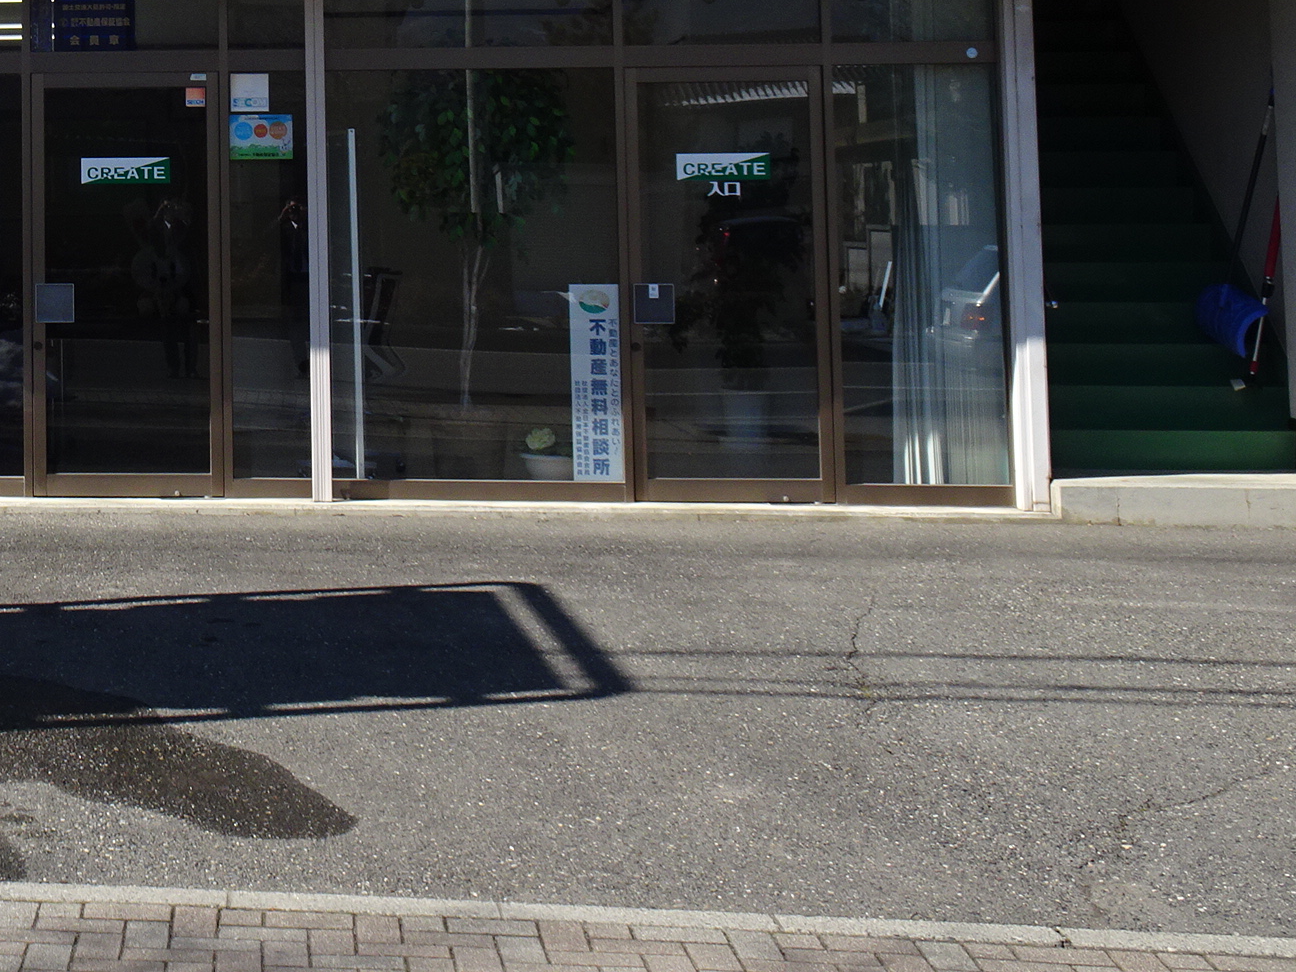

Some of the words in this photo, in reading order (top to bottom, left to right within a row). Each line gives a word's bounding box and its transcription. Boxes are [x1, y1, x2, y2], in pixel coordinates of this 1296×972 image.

[86, 165, 167, 180] CREATE
[682, 161, 767, 177] CREATE
[706, 181, 742, 197] 入口
[589, 318, 611, 476] 不動産無料相談所
